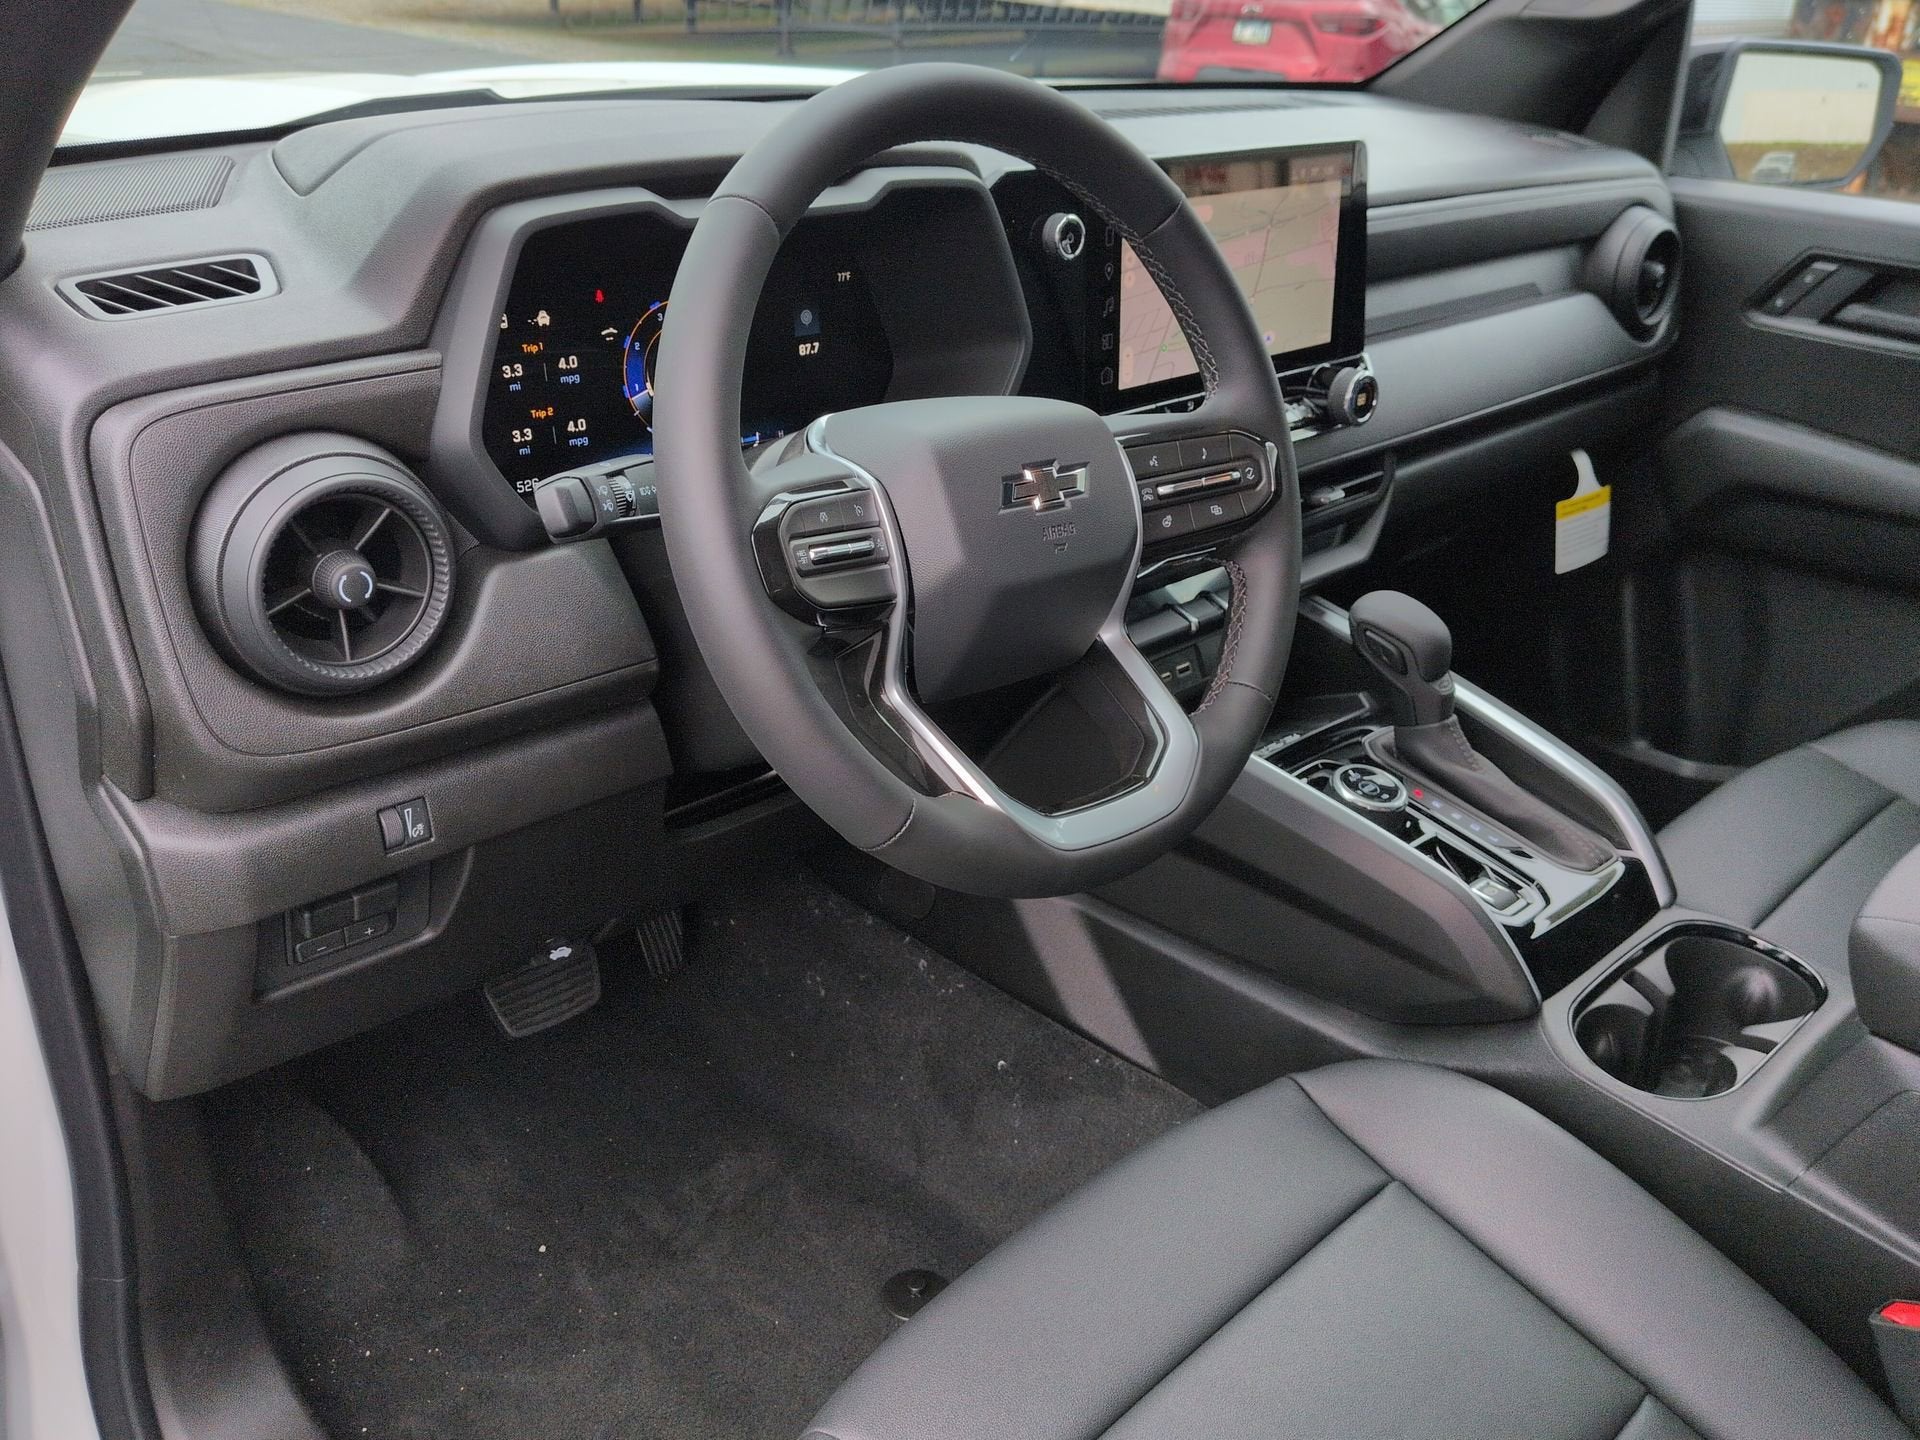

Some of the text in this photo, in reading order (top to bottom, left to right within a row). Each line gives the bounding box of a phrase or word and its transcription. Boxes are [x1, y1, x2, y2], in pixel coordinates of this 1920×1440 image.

[657, 313, 664, 321] 3
[521, 344, 539, 354] Trip
[634, 342, 641, 351] 2
[799, 341, 820, 356] 87.7
[502, 355, 578, 378] 3.3 4.0
[509, 374, 580, 392] mi mpg
[530, 407, 554, 420] Trip 2
[512, 418, 587, 443] 3.3 4.0
[519, 437, 589, 456] mi mpg
